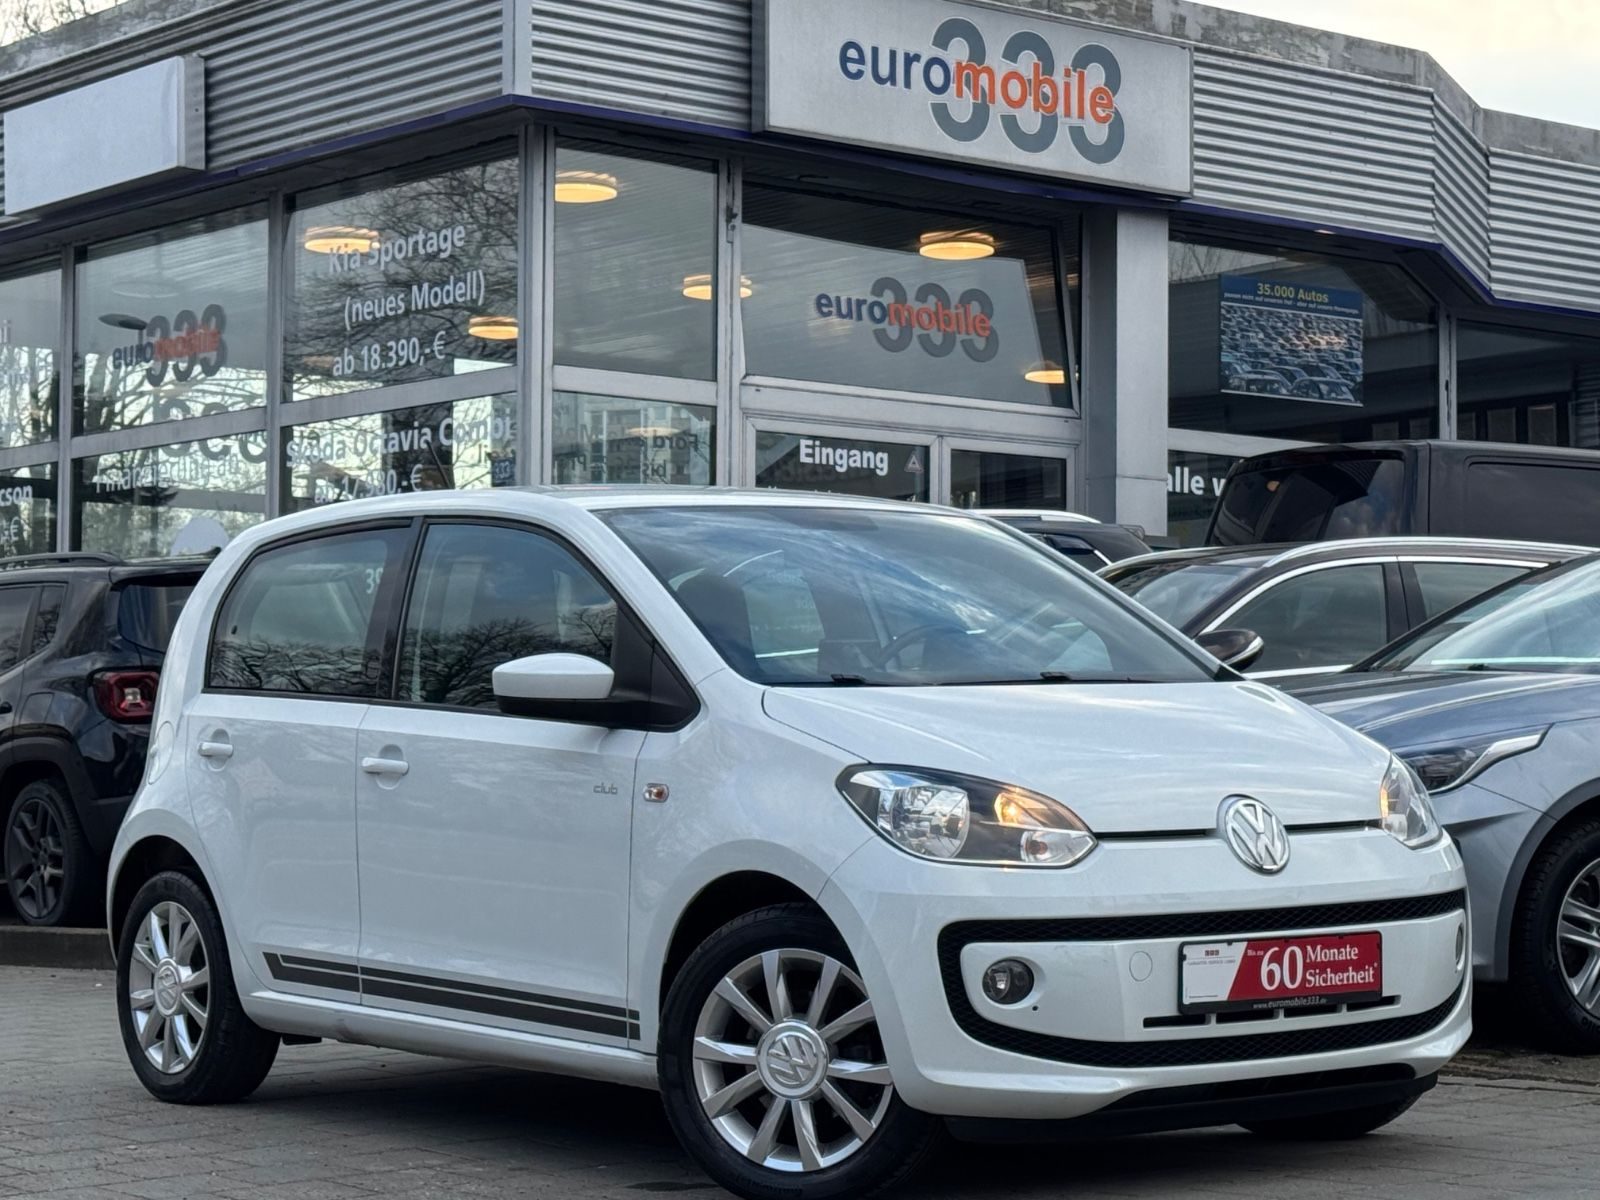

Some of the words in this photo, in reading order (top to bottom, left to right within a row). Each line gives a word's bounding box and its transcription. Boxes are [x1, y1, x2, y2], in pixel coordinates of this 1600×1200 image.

[839, 40, 1115, 124] euromobile
[329, 243, 361, 274] Kia
[344, 296, 405, 331] (neues
[411, 270, 486, 312] Modell)
[1257, 282, 1295, 299] 35.000
[1298, 286, 1329, 303] Autos
[815, 292, 991, 338] euromobile
[333, 347, 355, 376] ab
[354, 421, 432, 458] Octavia
[799, 439, 889, 476] Eingang
[1260, 945, 1304, 991] 60
[1306, 944, 1359, 963] Monate
